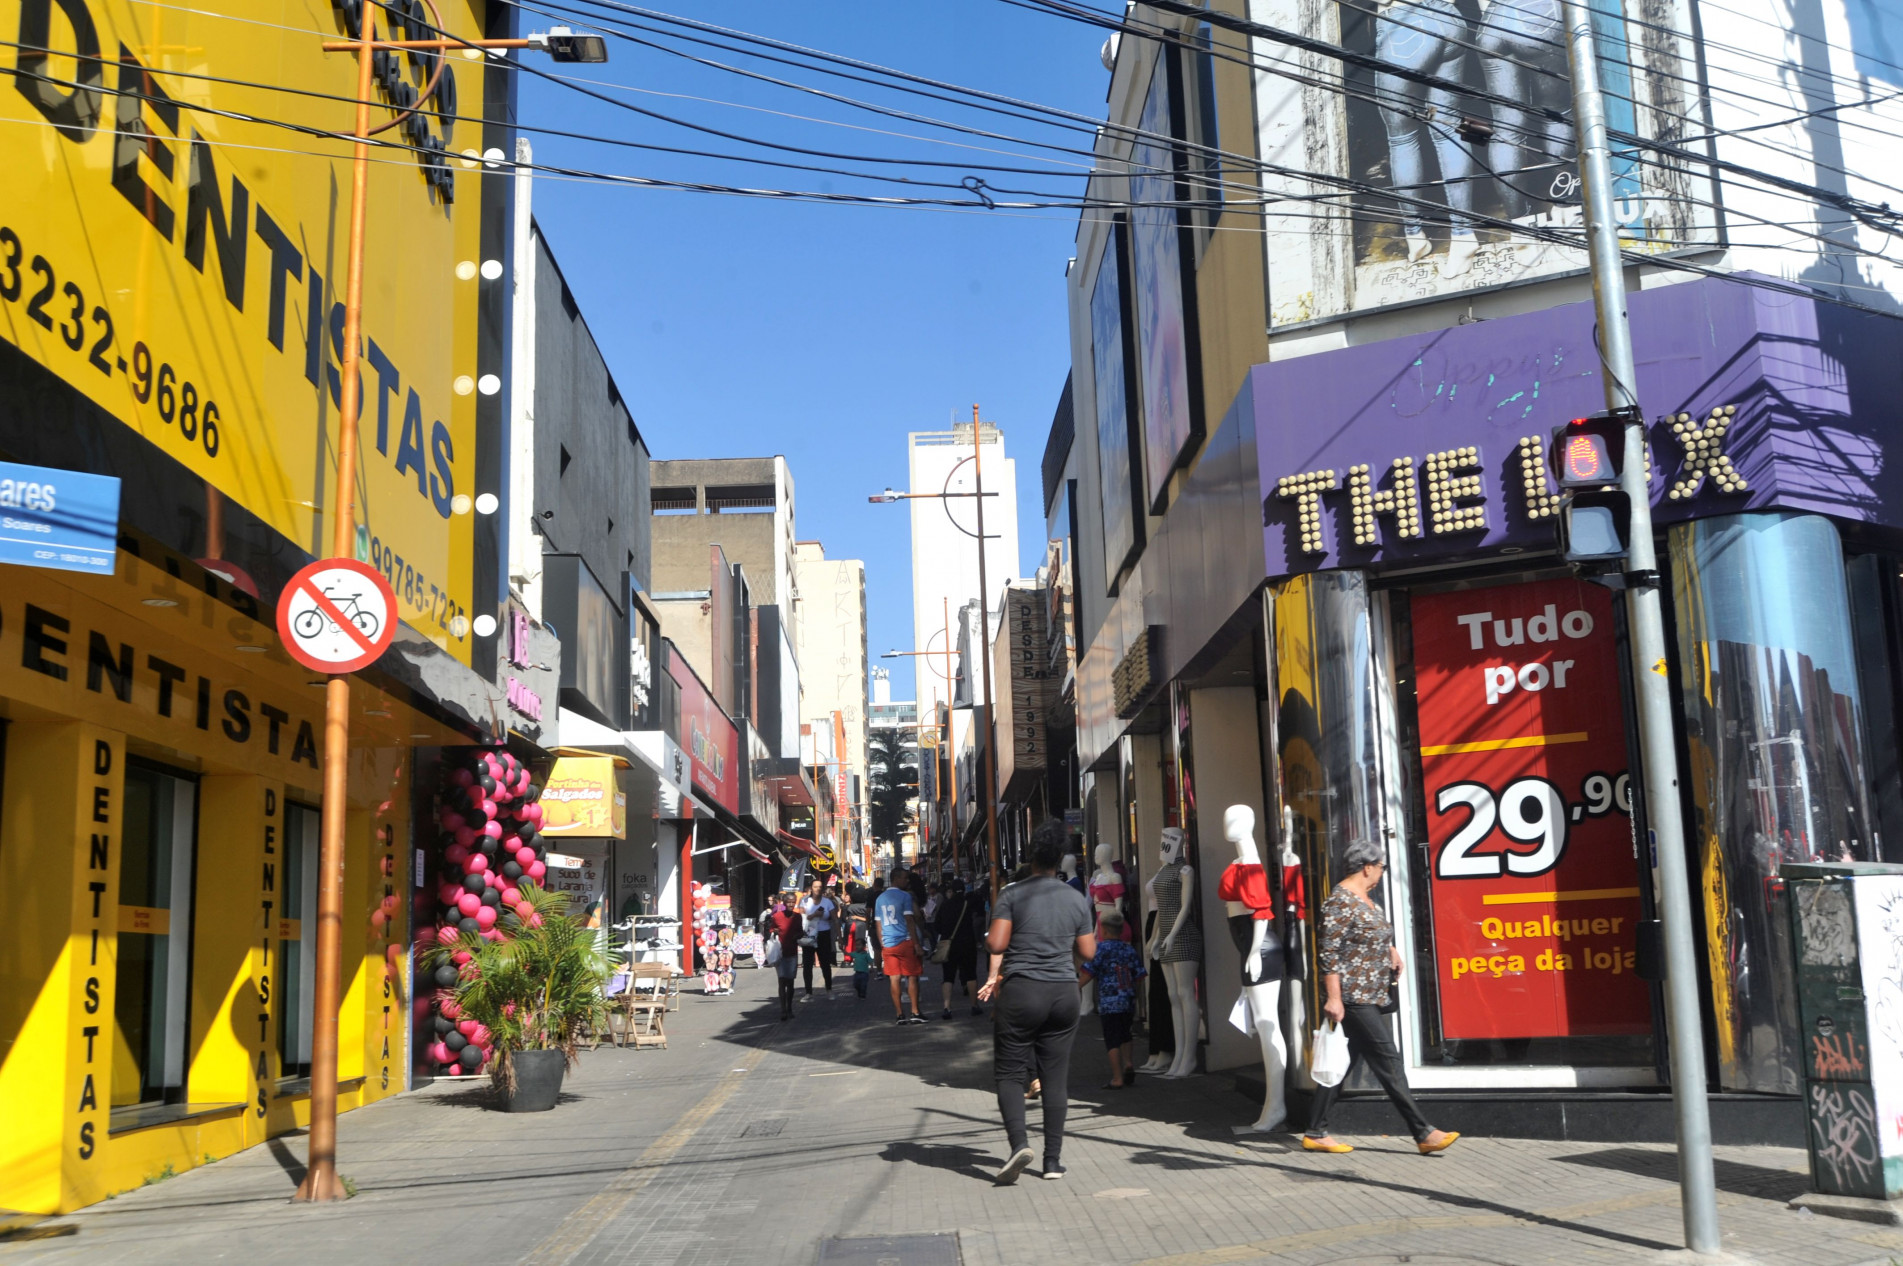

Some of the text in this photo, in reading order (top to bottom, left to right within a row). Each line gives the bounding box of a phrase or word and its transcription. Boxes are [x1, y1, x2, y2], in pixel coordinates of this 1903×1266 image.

[15, 0, 454, 519] DENTISTAS
[1278, 404, 1750, 552] THE LX
[2, 517, 52, 534] Soares
[1020, 605, 1034, 678] DESDE
[1458, 604, 1595, 651] Tudo
[0, 602, 318, 769] ENTISTA
[1484, 657, 1575, 704] por
[1025, 695, 1037, 753] 1992
[541, 788, 604, 802] Salgados
[558, 869, 596, 880] Suco de
[558, 881, 593, 893] Laranja
[623, 873, 648, 883] foka
[881, 905, 898, 926] 12
[1481, 912, 1624, 941] Qualquer
[78, 739, 112, 1160] DENTISTAS
[256, 788, 276, 1119] DENTISTAS
[380, 823, 395, 1091] DENTISTAS
[1451, 944, 1637, 981] peça da loja
